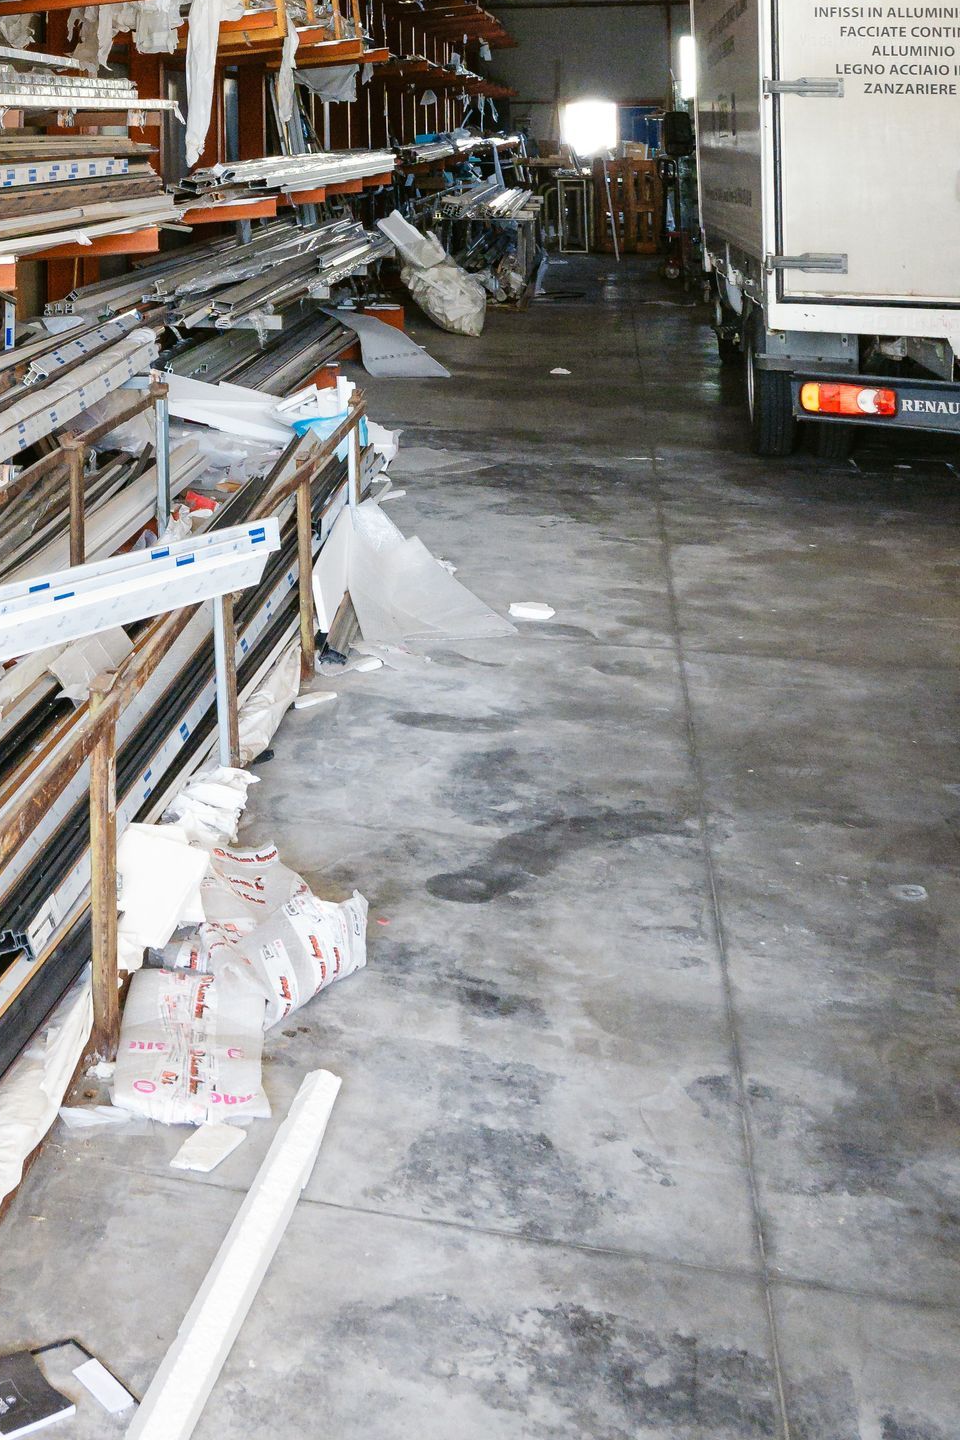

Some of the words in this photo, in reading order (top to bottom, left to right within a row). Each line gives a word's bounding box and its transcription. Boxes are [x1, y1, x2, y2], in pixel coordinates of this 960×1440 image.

[814, 6, 864, 18] INFISSI
[868, 7, 882, 18] IN
[840, 26, 907, 38] FACCIATE
[911, 26, 960, 38] CONTI
[872, 46, 955, 57] ALLUMINIO
[836, 64, 885, 76] LEGNO
[889, 65, 950, 76] ACCIAIO
[954, 65, 960, 76] I
[864, 83, 957, 95] ZANZARIERE
[901, 399, 960, 414] RENAU
